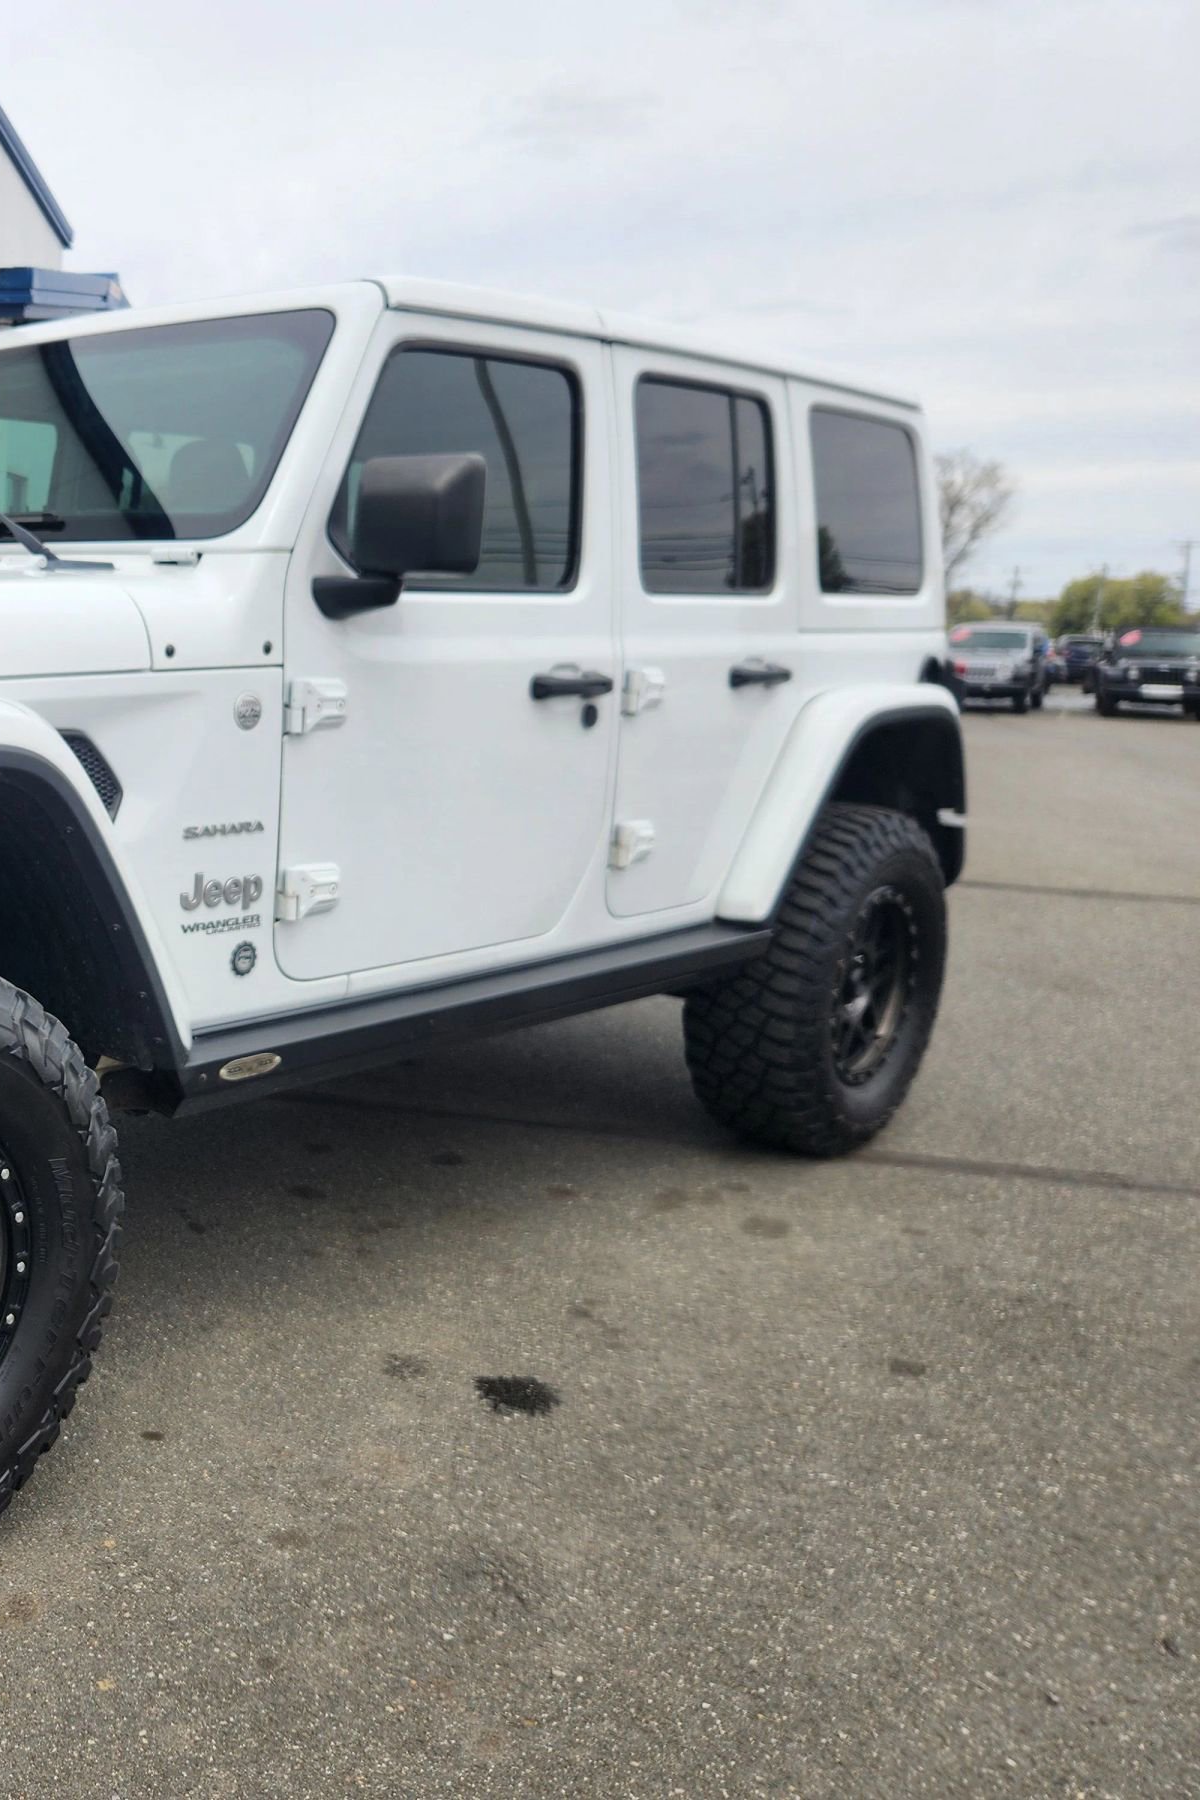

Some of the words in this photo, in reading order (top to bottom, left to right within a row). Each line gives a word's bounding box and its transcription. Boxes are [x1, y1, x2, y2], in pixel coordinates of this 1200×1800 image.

[183, 821, 264, 840] SAHARA
[180, 872, 263, 911] Jeep
[181, 914, 260, 933] WRANGLER
